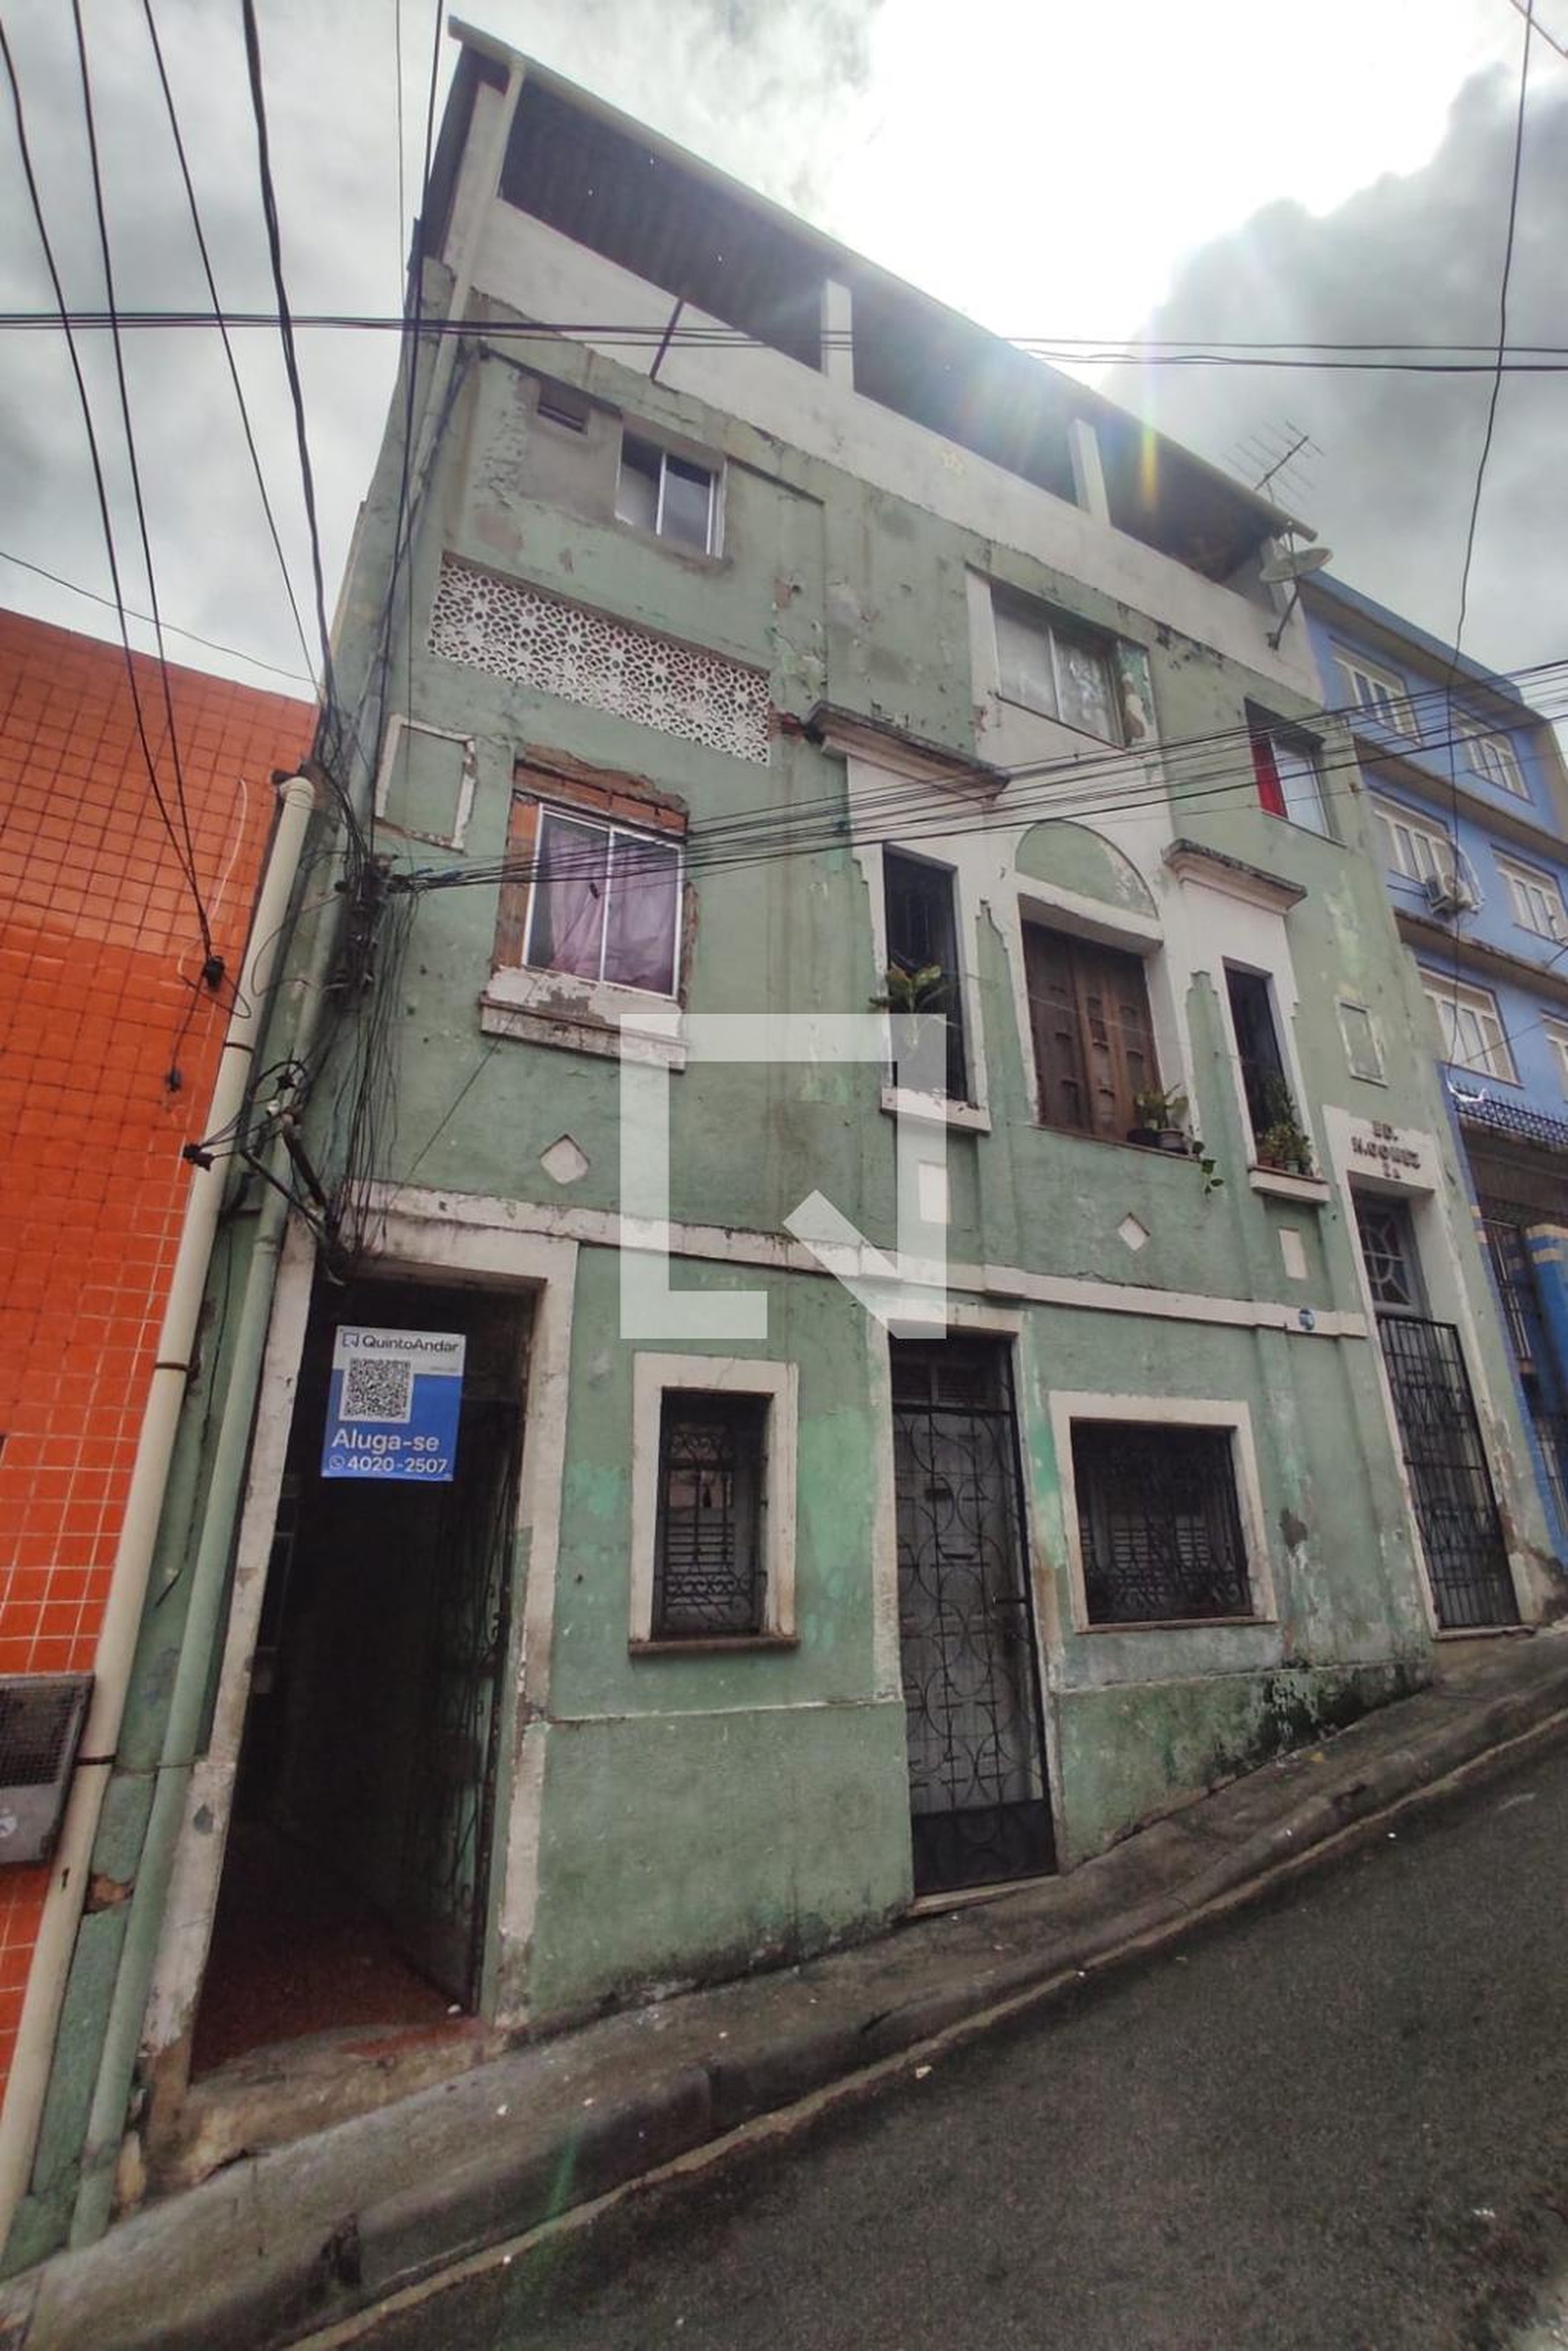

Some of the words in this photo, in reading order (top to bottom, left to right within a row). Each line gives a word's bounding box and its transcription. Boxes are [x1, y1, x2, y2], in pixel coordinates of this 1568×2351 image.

[363, 1334, 459, 1352] QuintoAndar
[332, 1428, 440, 1454] Aluga-se
[347, 1457, 447, 1473] 4020-2507
